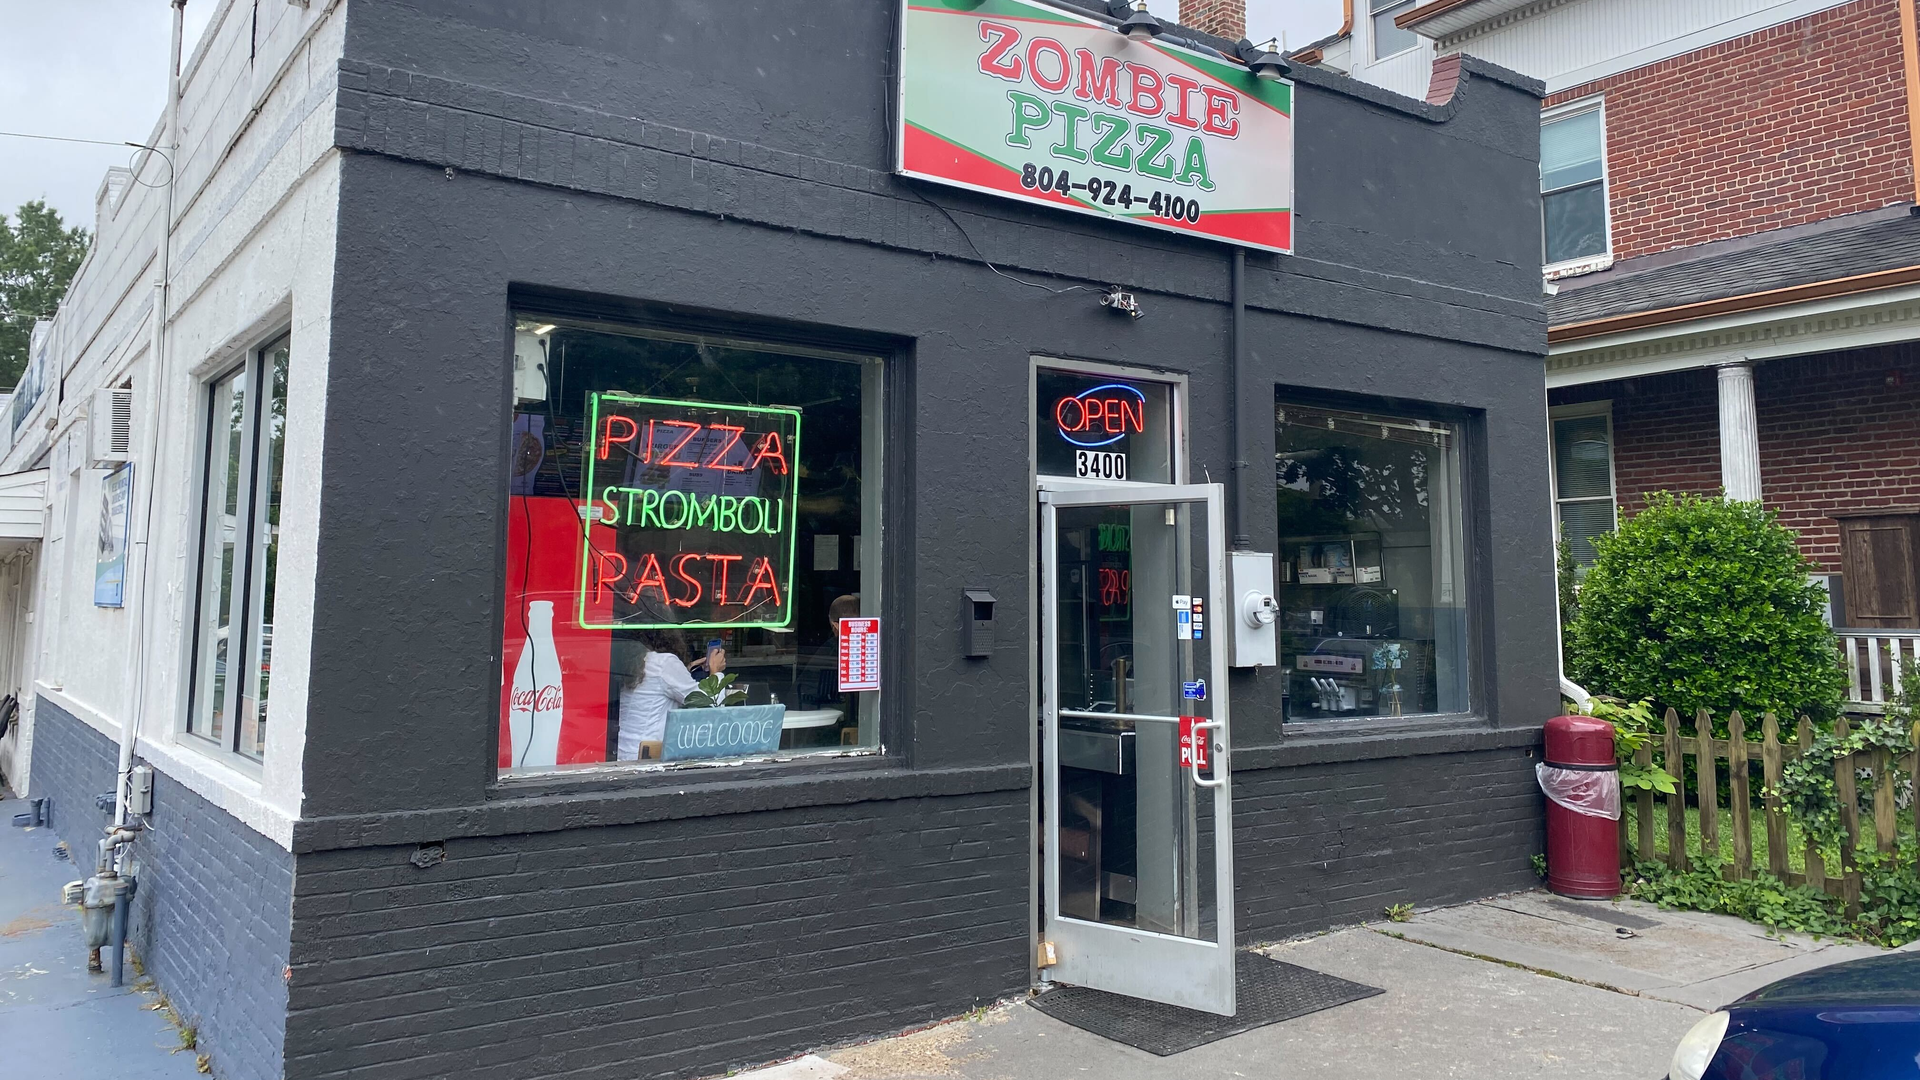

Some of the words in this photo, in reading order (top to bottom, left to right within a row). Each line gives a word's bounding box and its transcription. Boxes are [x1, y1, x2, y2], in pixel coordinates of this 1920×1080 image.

[976, 19, 1241, 140] ZOMBIE
[1005, 89, 1216, 192] PIZZA
[1019, 161, 1201, 224] 804-924-4100
[1057, 397, 1144, 433] OPEN
[601, 415, 788, 475] PIZZA
[1078, 451, 1124, 479] 3400
[600, 486, 782, 534] STROMBOLI
[595, 553, 781, 607] PASTA
[511, 685, 562, 712] Coca-Cola
[677, 720, 773, 749] WELCOME
